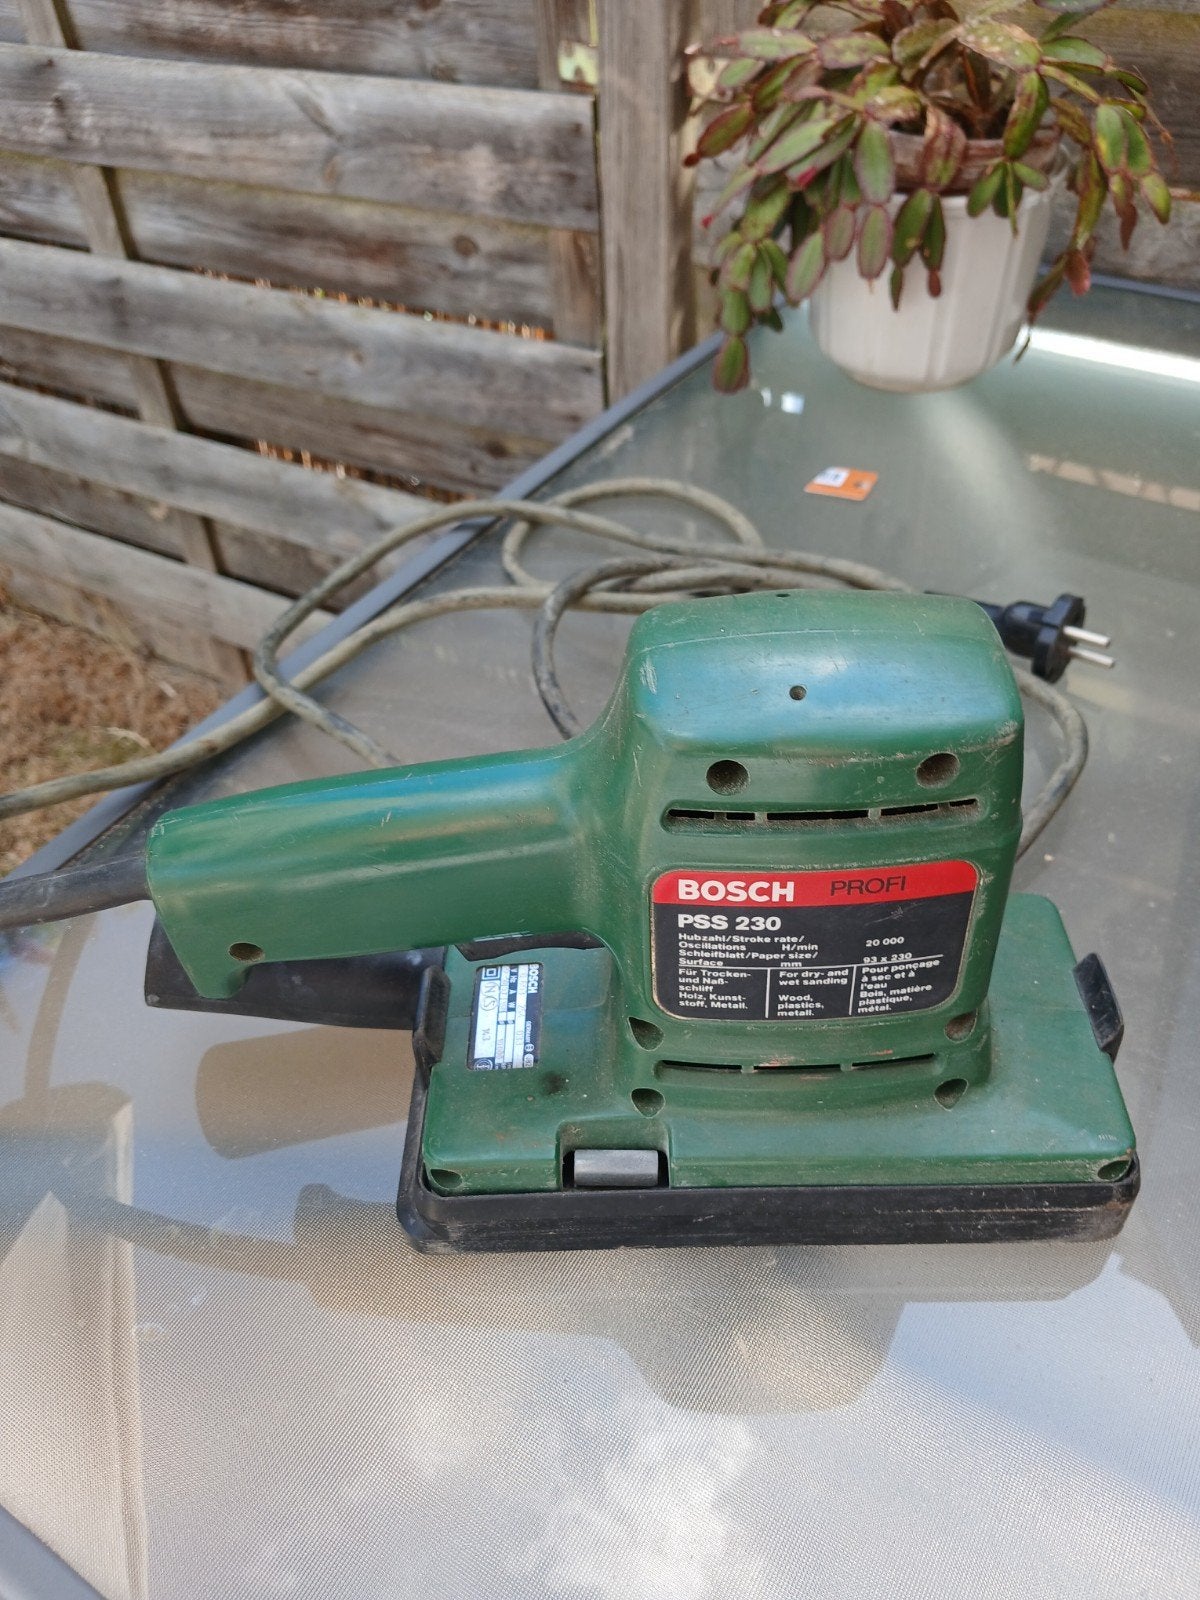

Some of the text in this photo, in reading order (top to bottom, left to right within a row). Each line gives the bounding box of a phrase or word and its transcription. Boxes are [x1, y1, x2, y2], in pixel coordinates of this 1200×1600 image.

[678, 876, 907, 902] BOSCH PROFI
[677, 913, 782, 931] PSS 230
[678, 933, 805, 943] Hubzahl/Stroke rate/
[865, 936, 905, 947] 20 000
[678, 941, 819, 951] Oscillations H/min
[678, 949, 819, 961] Schleifblatt/Paper size/
[863, 956, 877, 965] 93
[890, 952, 913, 961] 230
[678, 957, 724, 967] Surface
[861, 959, 941, 975] Pour ponçage
[678, 969, 752, 978] Für Trocken-
[779, 969, 849, 979] For dry- and
[861, 970, 916, 983] à sec et à
[778, 977, 848, 986] wet sanding
[678, 984, 714, 993] schliff
[889, 984, 932, 996] matière
[709, 993, 747, 1001] Kunst-
[778, 994, 814, 1002] Wood,
[858, 995, 913, 1007] plastique,
[710, 1001, 749, 1010] Metall.
[777, 1002, 825, 1010] plastics,
[857, 1004, 892, 1014] métal.
